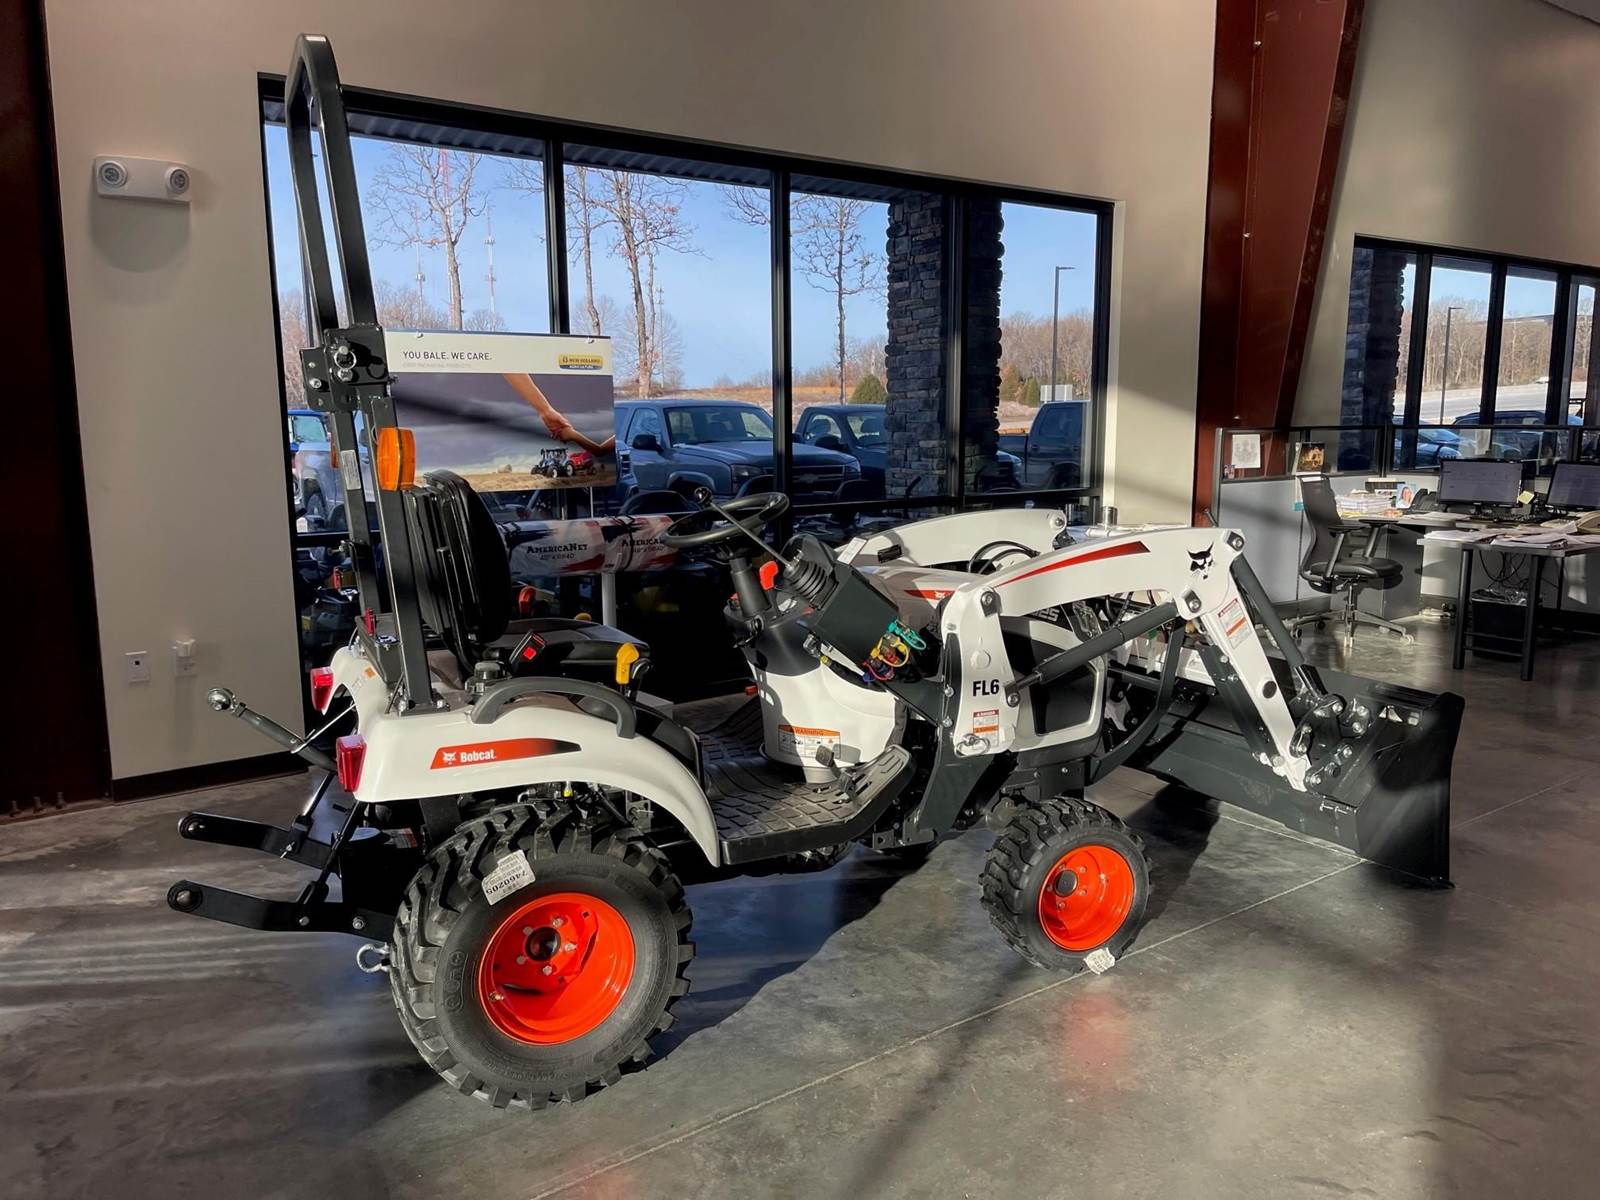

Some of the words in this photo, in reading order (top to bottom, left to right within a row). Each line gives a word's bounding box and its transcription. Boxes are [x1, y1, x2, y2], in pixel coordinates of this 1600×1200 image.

[403, 351, 421, 360] YOU
[423, 351, 449, 360] BALE.
[451, 352, 465, 360] WE
[466, 352, 493, 361] CARE.
[972, 679, 1000, 697] FL6
[460, 749, 496, 763] Bobcat
